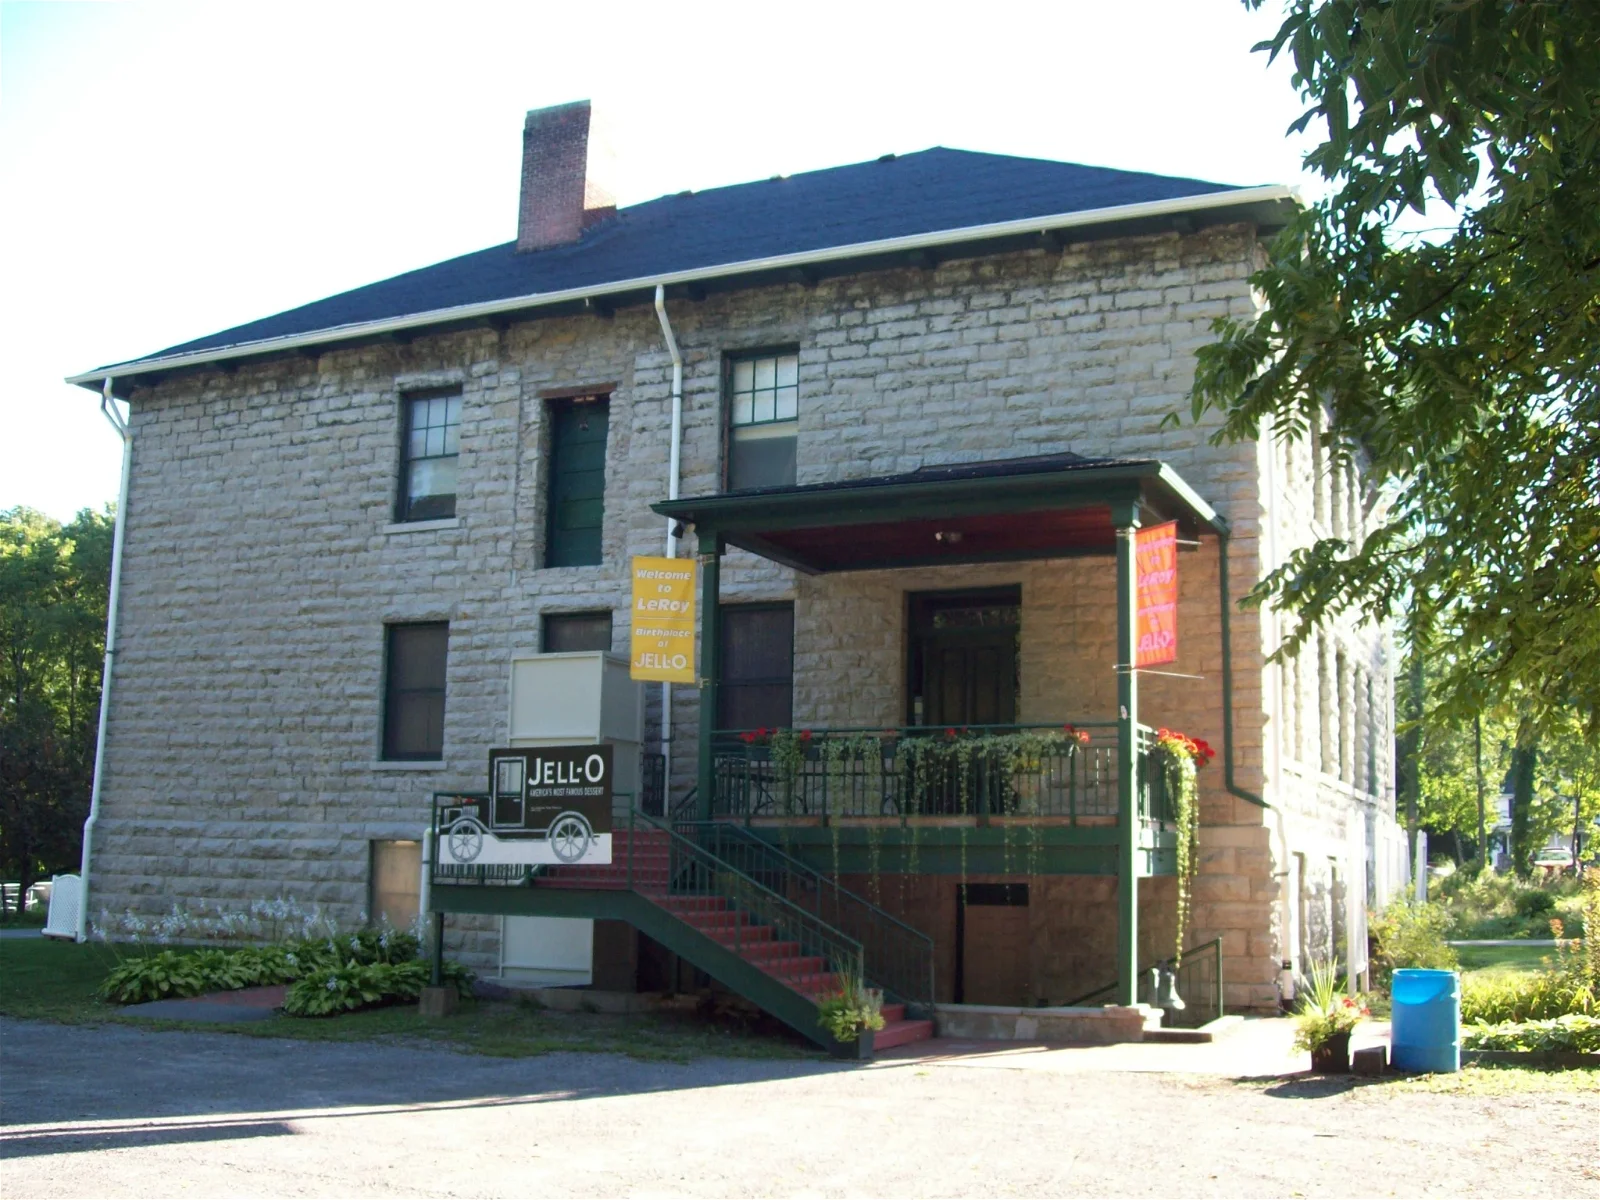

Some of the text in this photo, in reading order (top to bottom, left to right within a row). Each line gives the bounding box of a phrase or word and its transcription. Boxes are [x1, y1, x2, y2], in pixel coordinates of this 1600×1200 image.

[636, 569, 692, 580] Welcome
[657, 583, 672, 593] to
[636, 597, 690, 613] LeRoy
[635, 628, 692, 637] Birthplace
[657, 640, 669, 648] of
[528, 754, 604, 786] JELL-O
[529, 786, 604, 797] AMERICA'S MOST FAMOUS DESSERT
